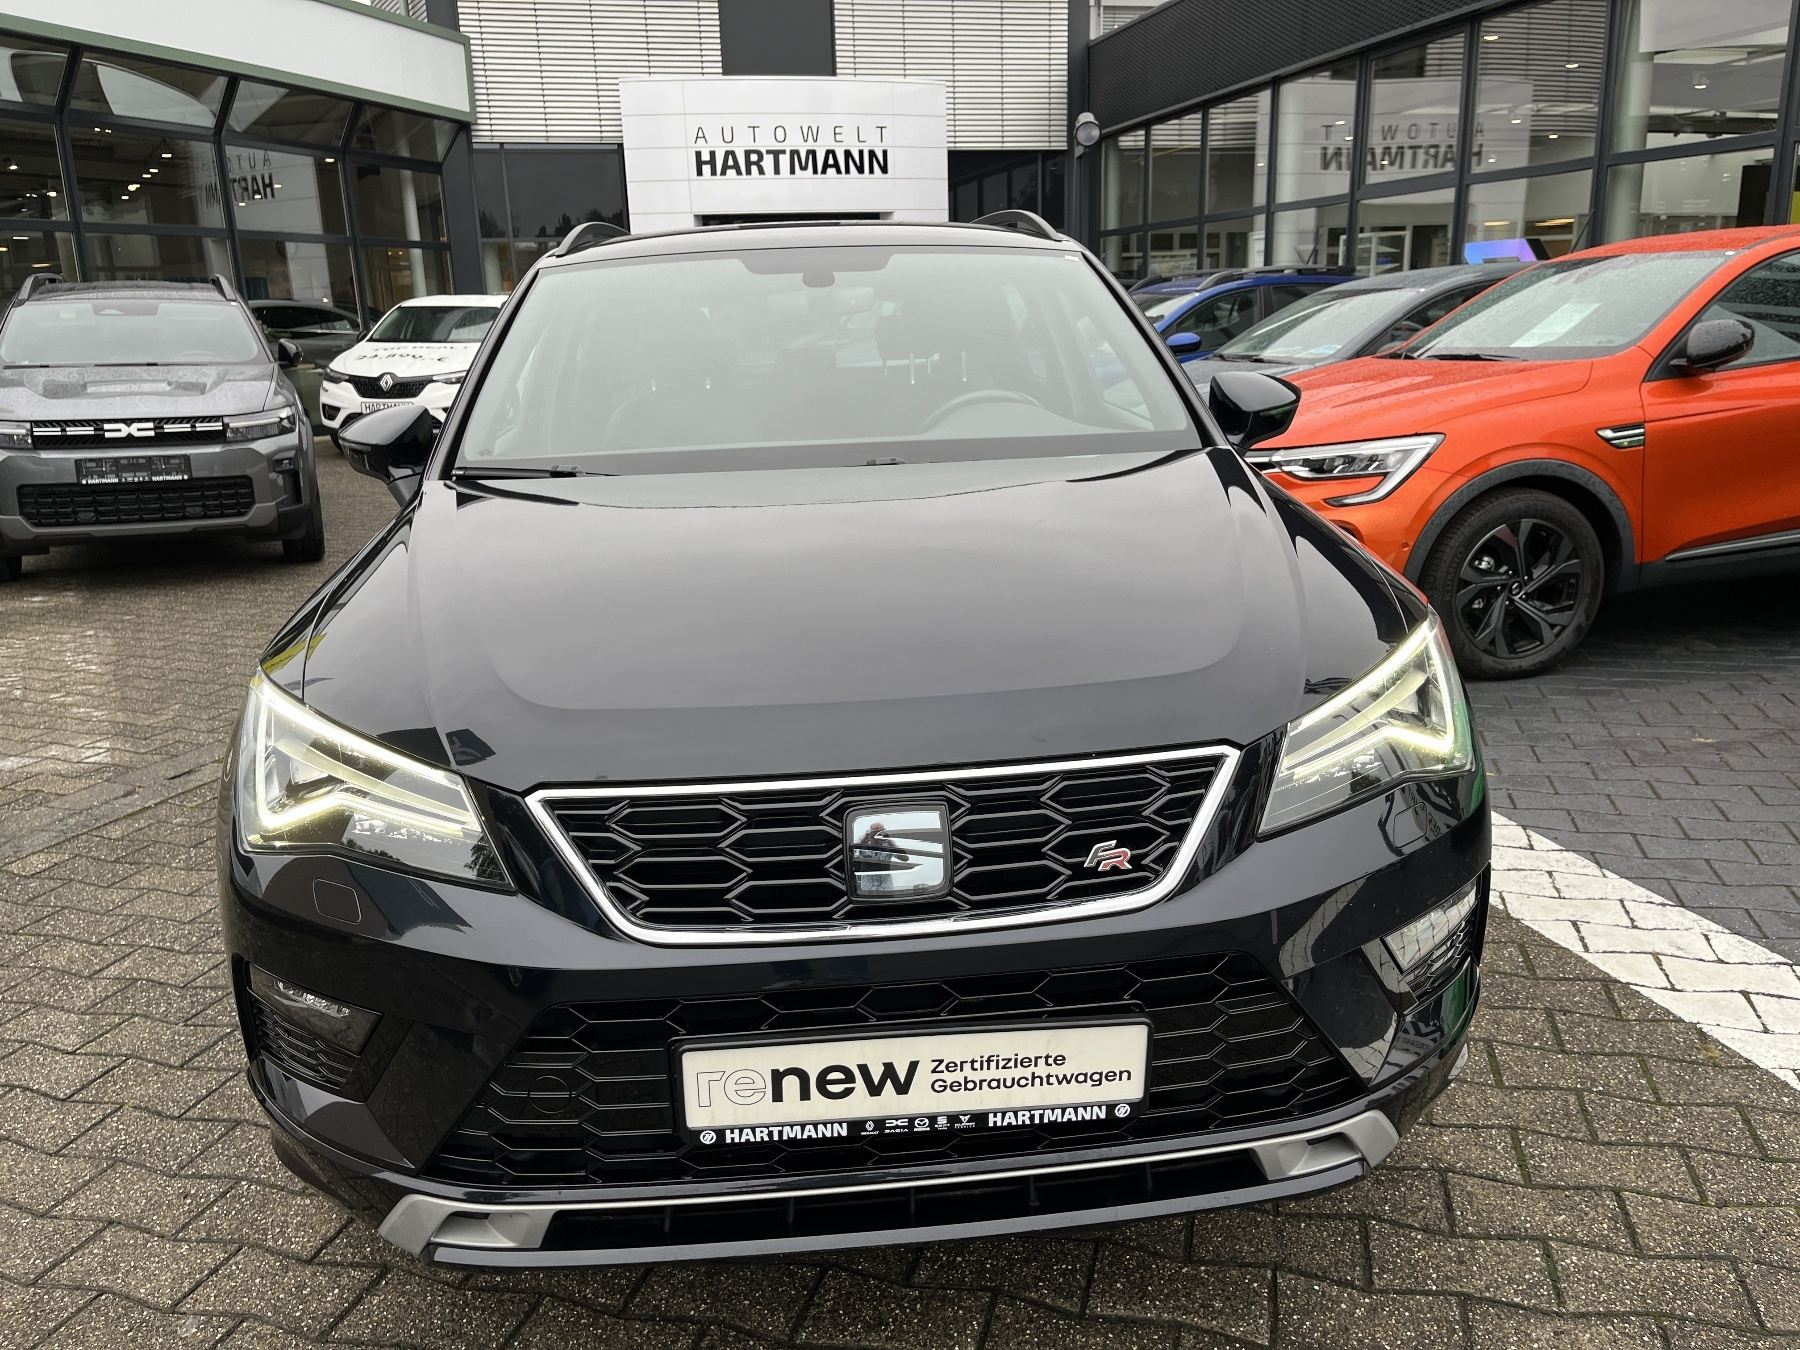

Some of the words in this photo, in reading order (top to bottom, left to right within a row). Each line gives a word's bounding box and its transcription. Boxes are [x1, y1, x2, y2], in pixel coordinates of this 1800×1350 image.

[694, 125, 887, 144] AUTOWELT
[694, 149, 889, 177] HARTMANN
[1083, 840, 1132, 871] FR
[931, 1053, 1066, 1074] Zertifizierte
[697, 1060, 920, 1108] renew
[931, 1069, 1132, 1094] Gebrauchtwagen
[988, 1105, 1107, 1127] HARTMANN
[725, 1122, 848, 1144] HARTMANN
